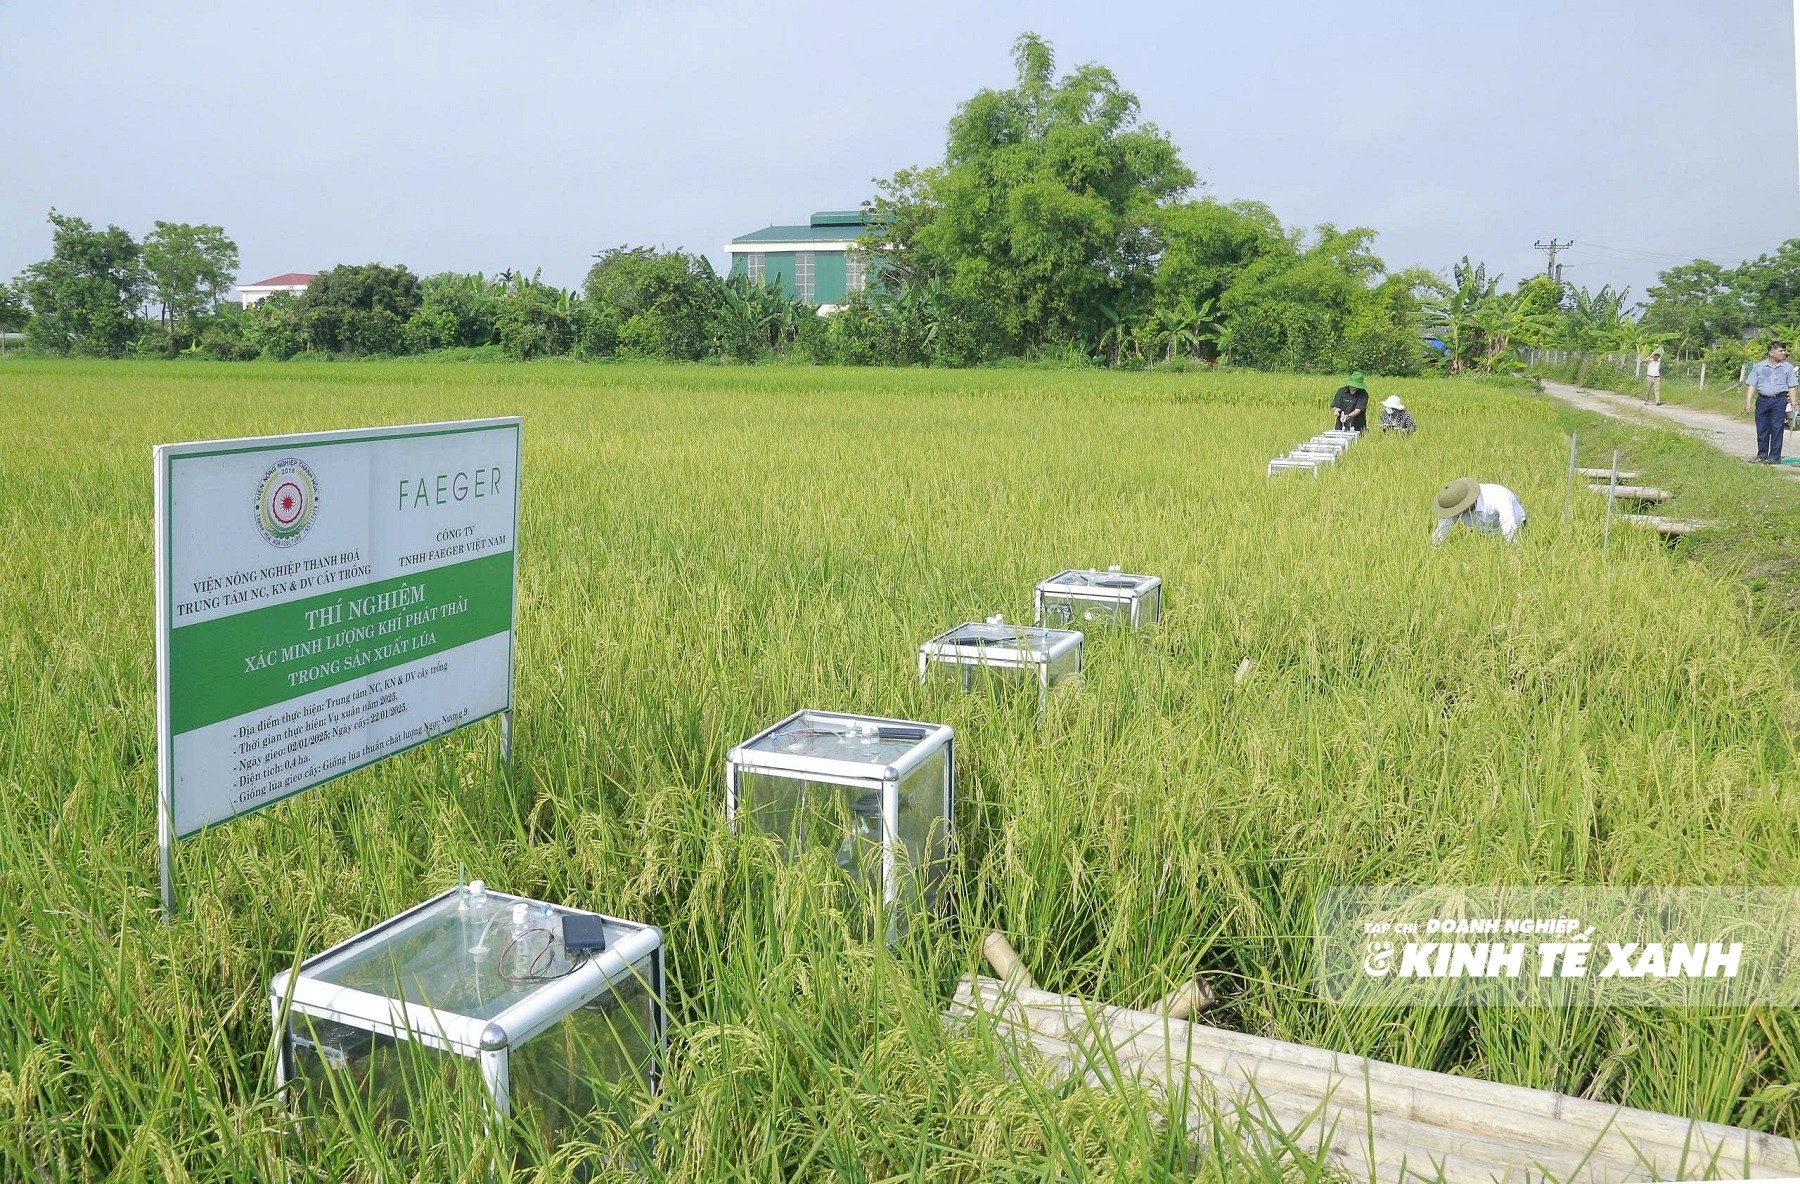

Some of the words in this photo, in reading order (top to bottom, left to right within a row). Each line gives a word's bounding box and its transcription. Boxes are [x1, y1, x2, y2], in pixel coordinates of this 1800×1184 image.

[399, 467, 501, 511] FAEGER
[399, 552, 426, 567] TNHH
[428, 544, 464, 561] FAEGER
[466, 538, 487, 552] VIỆT
[488, 535, 506, 547] NAM
[436, 528, 461, 542] CÔNG
[464, 526, 475, 537] TY
[177, 598, 220, 616] TRUNG
[223, 591, 248, 606] TÂM
[251, 587, 269, 600] NC,
[272, 582, 287, 595] KN
[289, 581, 297, 592] &
[300, 577, 314, 589] DV
[317, 571, 337, 585] CÂY
[338, 563, 371, 580] TRỒNG
[194, 577, 222, 594] VIỆN
[225, 571, 257, 588] NÔNG
[260, 561, 301, 580] NGHIỆP
[304, 555, 337, 571] THANH
[340, 548, 360, 564] HOÁ
[304, 598, 343, 631] THÍ
[347, 582, 426, 621] NGHIỆM
[244, 649, 277, 673] XÁC
[281, 638, 321, 663] MINH
[326, 625, 375, 649] LƯỢNG
[378, 613, 402, 636] KHÍ
[405, 605, 438, 628] PHÁT
[441, 595, 468, 618] THẢI
[288, 657, 340, 687] TRONG
[344, 649, 371, 671] SẢN
[373, 635, 410, 662] XUẤT
[412, 631, 437, 650] LÚA
[239, 726, 255, 739] Địa
[257, 715, 280, 731] điểm
[281, 711, 301, 724] thực
[303, 704, 325, 717] hiện:
[326, 694, 351, 710] Trung
[352, 688, 367, 700] tâm
[368, 682, 383, 695] NC,
[384, 677, 396, 690] KN
[397, 676, 404, 686] &
[405, 671, 417, 683] DV
[417, 668, 429, 679] cây
[430, 661, 448, 674] trồng
[239, 739, 260, 754] Thời
[262, 734, 282, 749] gian
[284, 726, 304, 740] thực
[305, 718, 327, 732] hiện:
[327, 712, 339, 724] Vụ
[341, 705, 361, 719] xuân
[362, 700, 379, 712] năm
[239, 757, 262, 772] Ngày
[265, 748, 286, 763] gieo:
[332, 725, 352, 738] Ngày
[239, 784, 266, 803] Giống
[268, 780, 283, 792] lúa
[284, 772, 303, 787] gieo
[322, 754, 347, 771] Giống
[348, 749, 361, 761] lúa
[385, 731, 402, 746] chất
[463, 707, 468, 716] 9
[239, 772, 261, 788] Diện
[263, 765, 283, 778] tích:
[284, 759, 296, 770] 0,4
[298, 754, 311, 765] ha.
